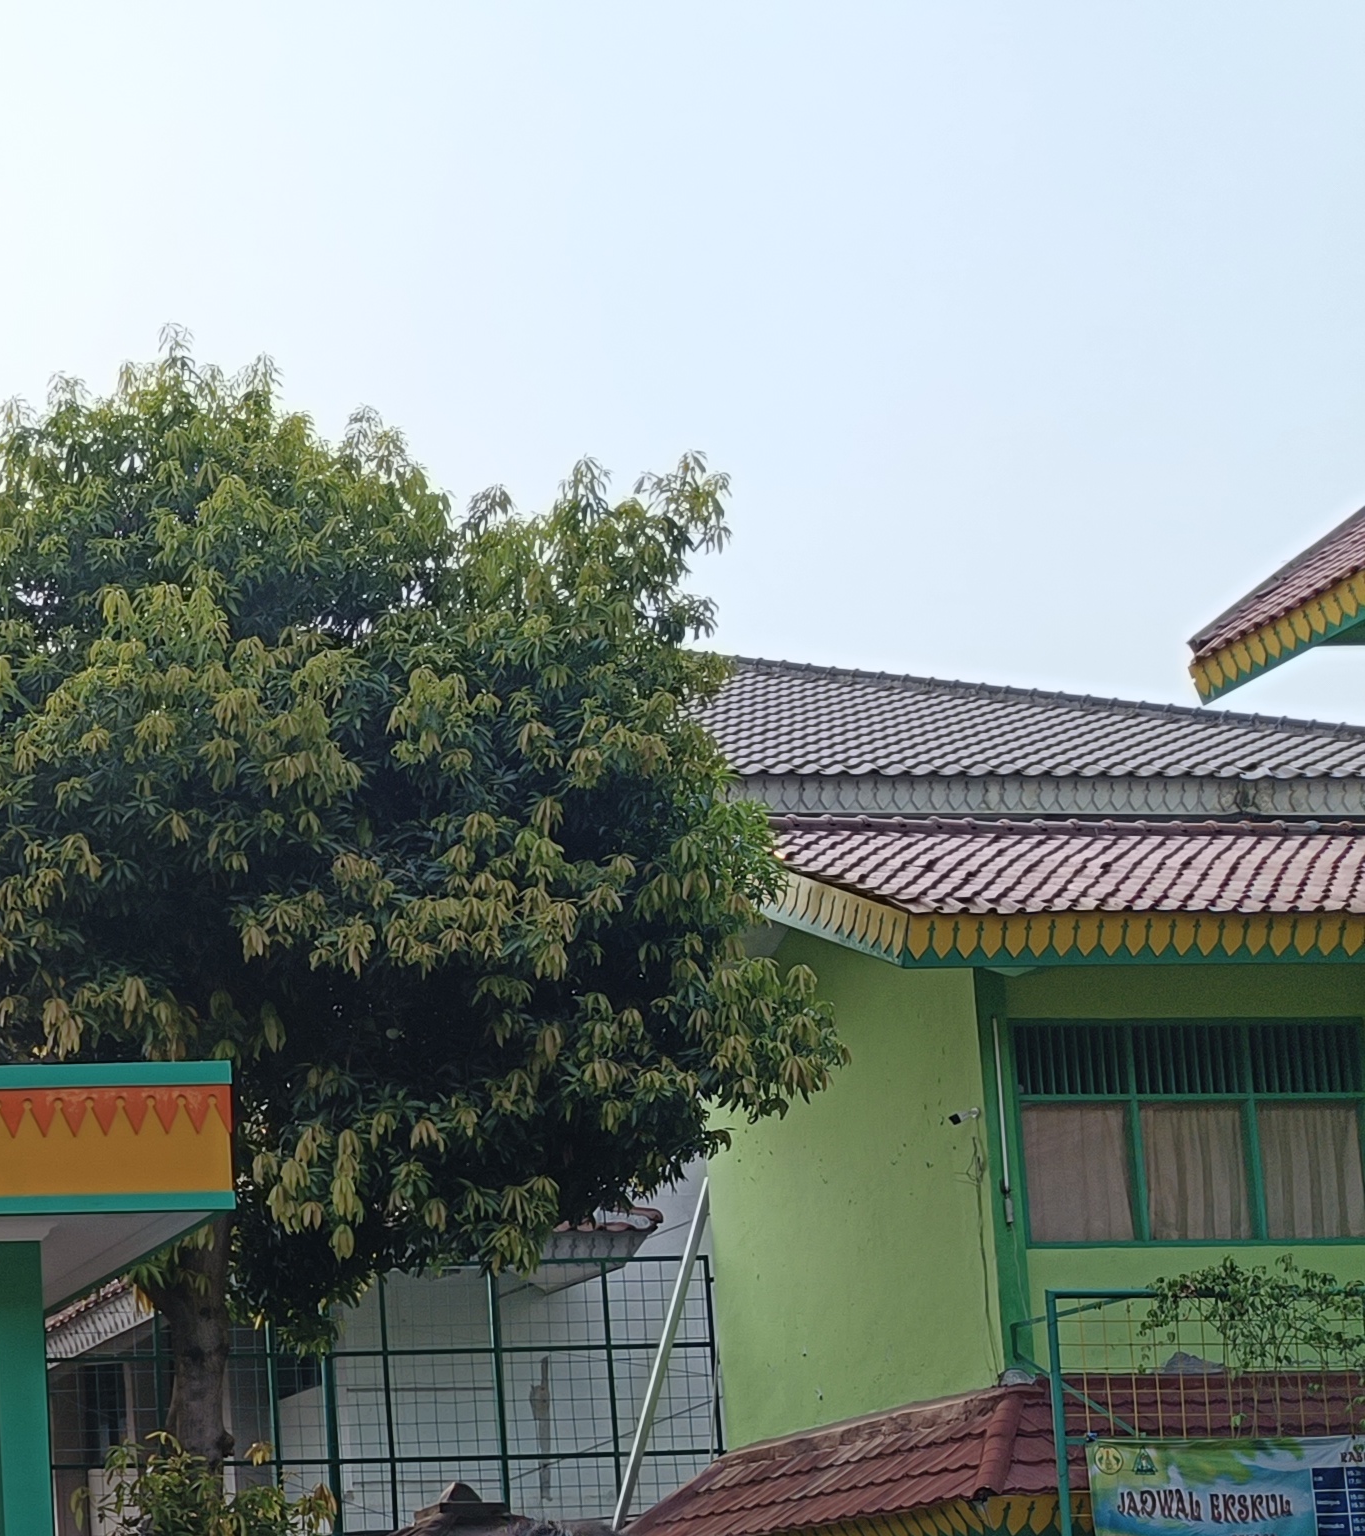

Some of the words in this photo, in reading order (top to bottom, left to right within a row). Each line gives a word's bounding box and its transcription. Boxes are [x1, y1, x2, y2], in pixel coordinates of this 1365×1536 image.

[1340, 1451, 1365, 1464] RAB
[1117, 1488, 1203, 1522] JADWAL
[1209, 1493, 1294, 1524] EKSKUL
